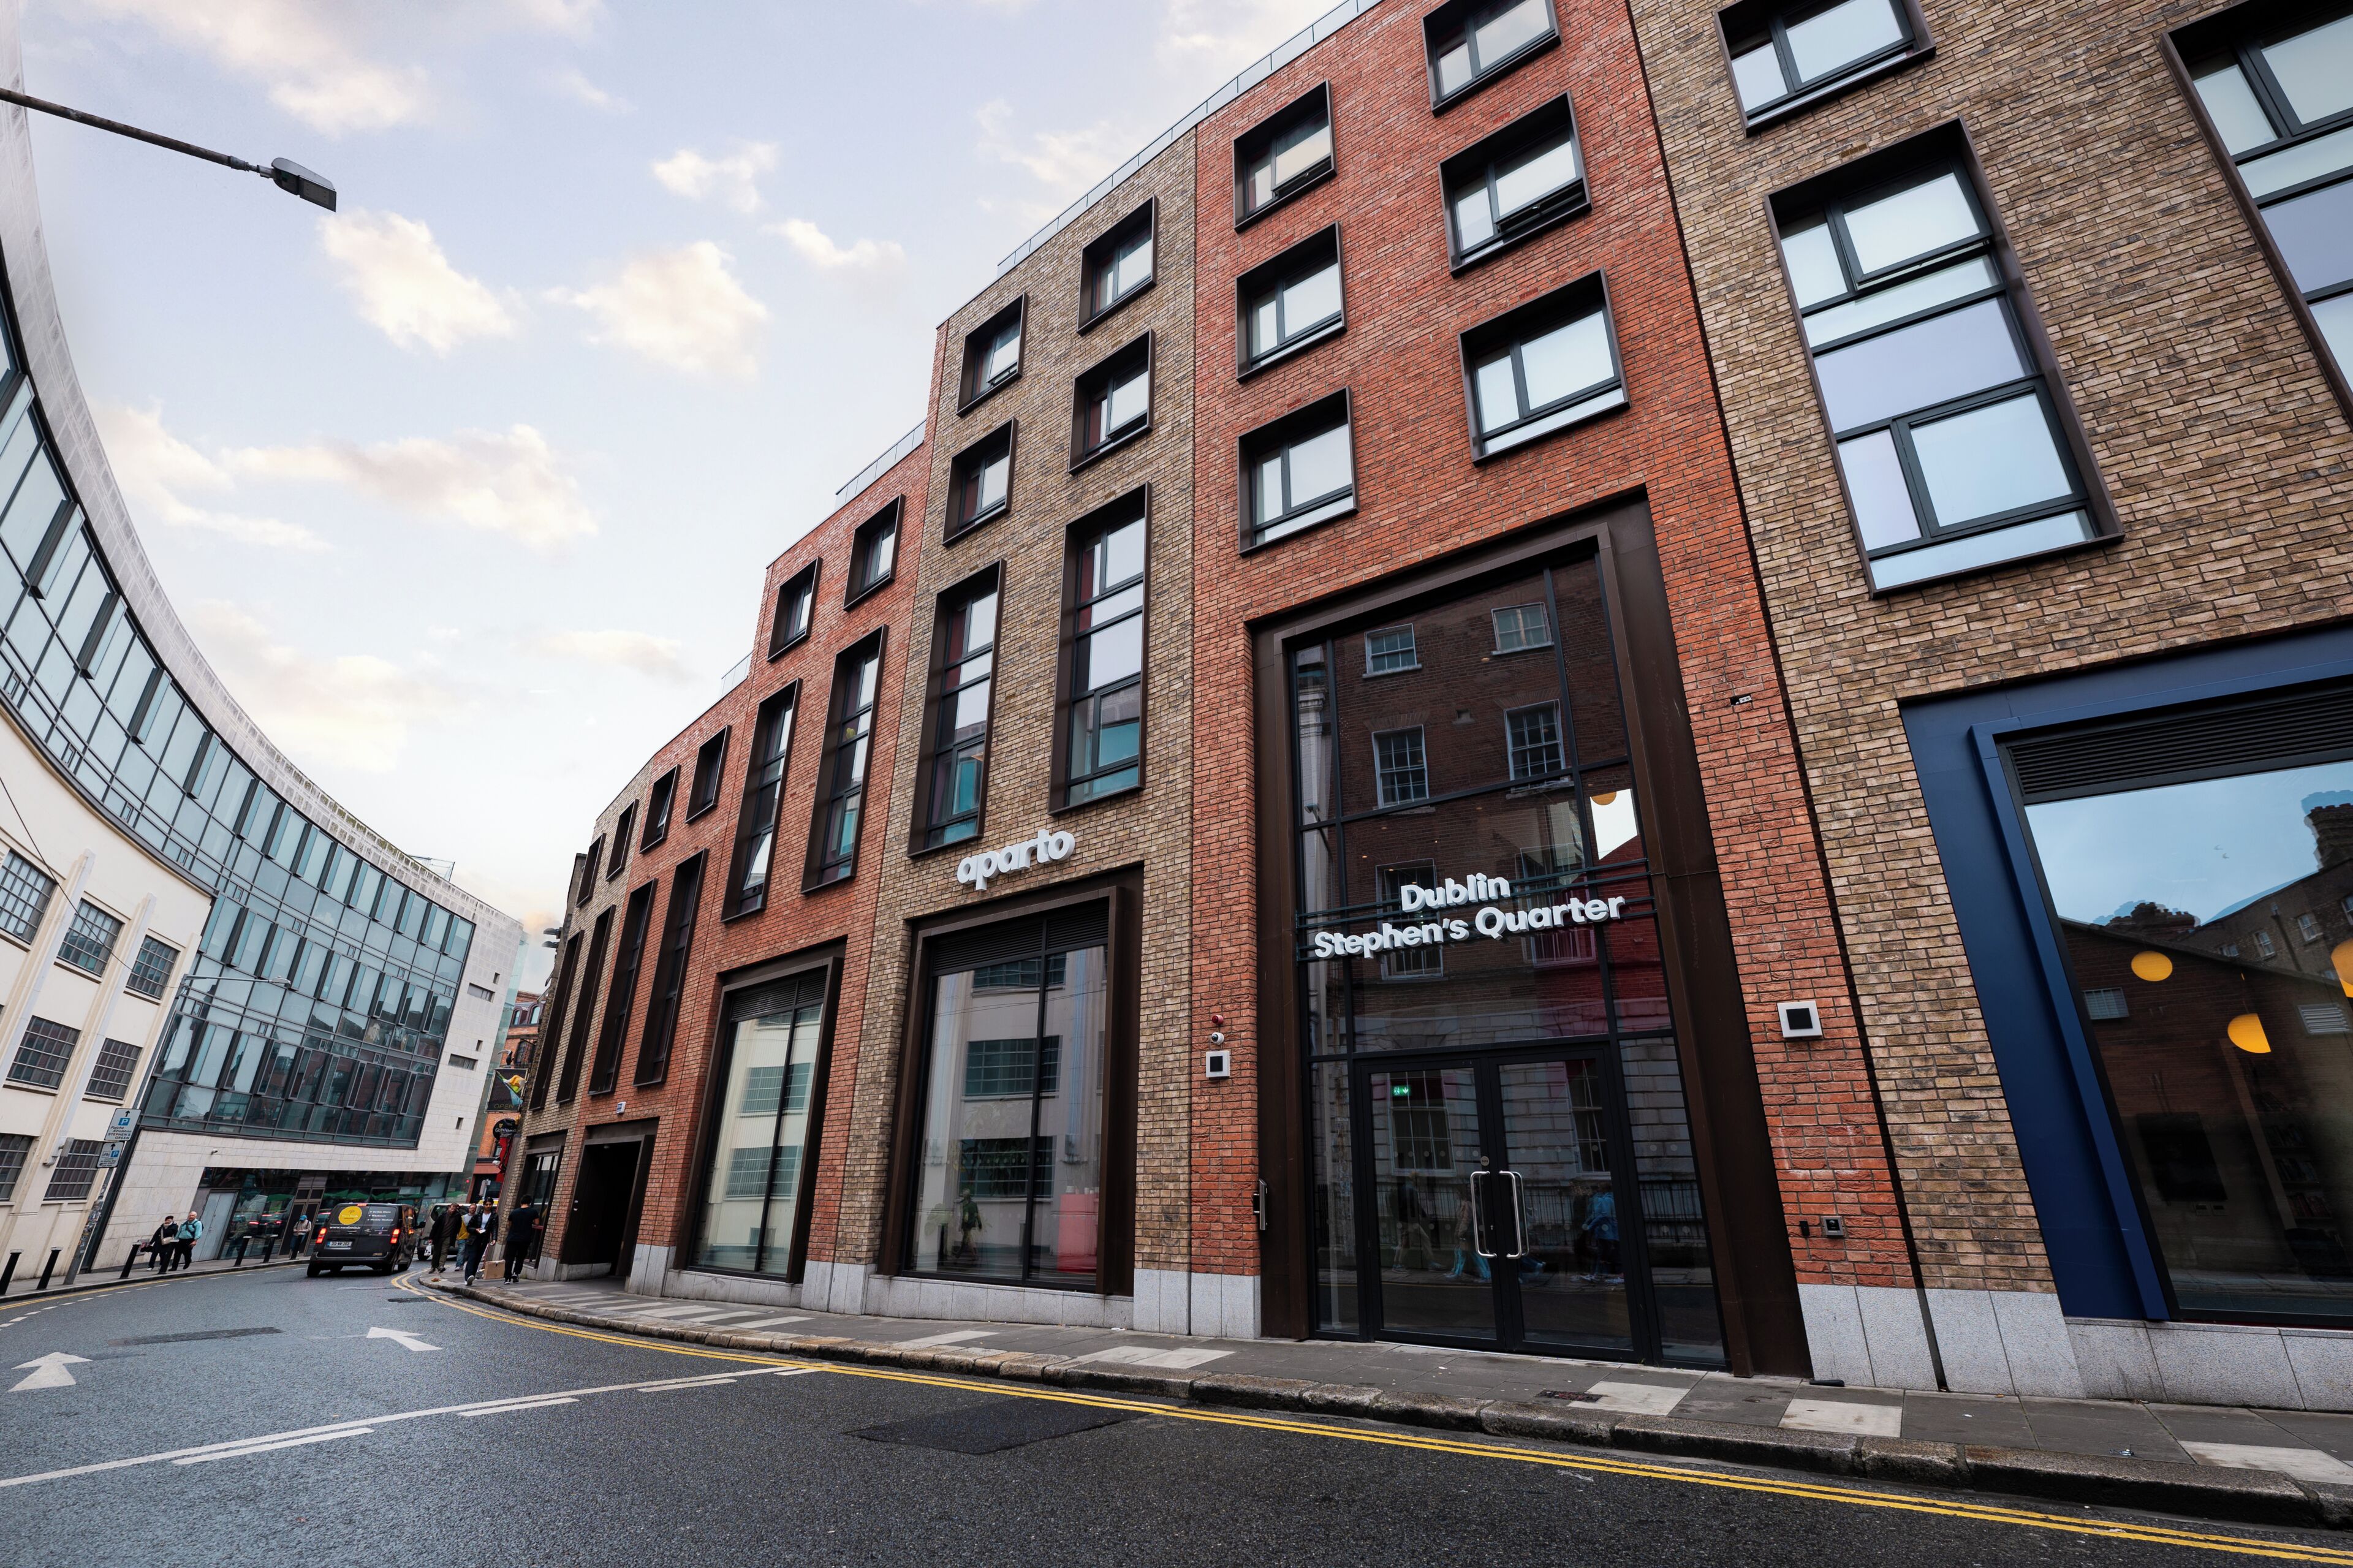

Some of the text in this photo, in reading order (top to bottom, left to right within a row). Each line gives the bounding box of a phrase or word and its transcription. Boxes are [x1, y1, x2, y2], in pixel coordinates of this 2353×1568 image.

[957, 828, 1075, 891] aparto
[1400, 872, 1512, 913] Dublin
[1314, 896, 1626, 960] Stephen's Quarter
